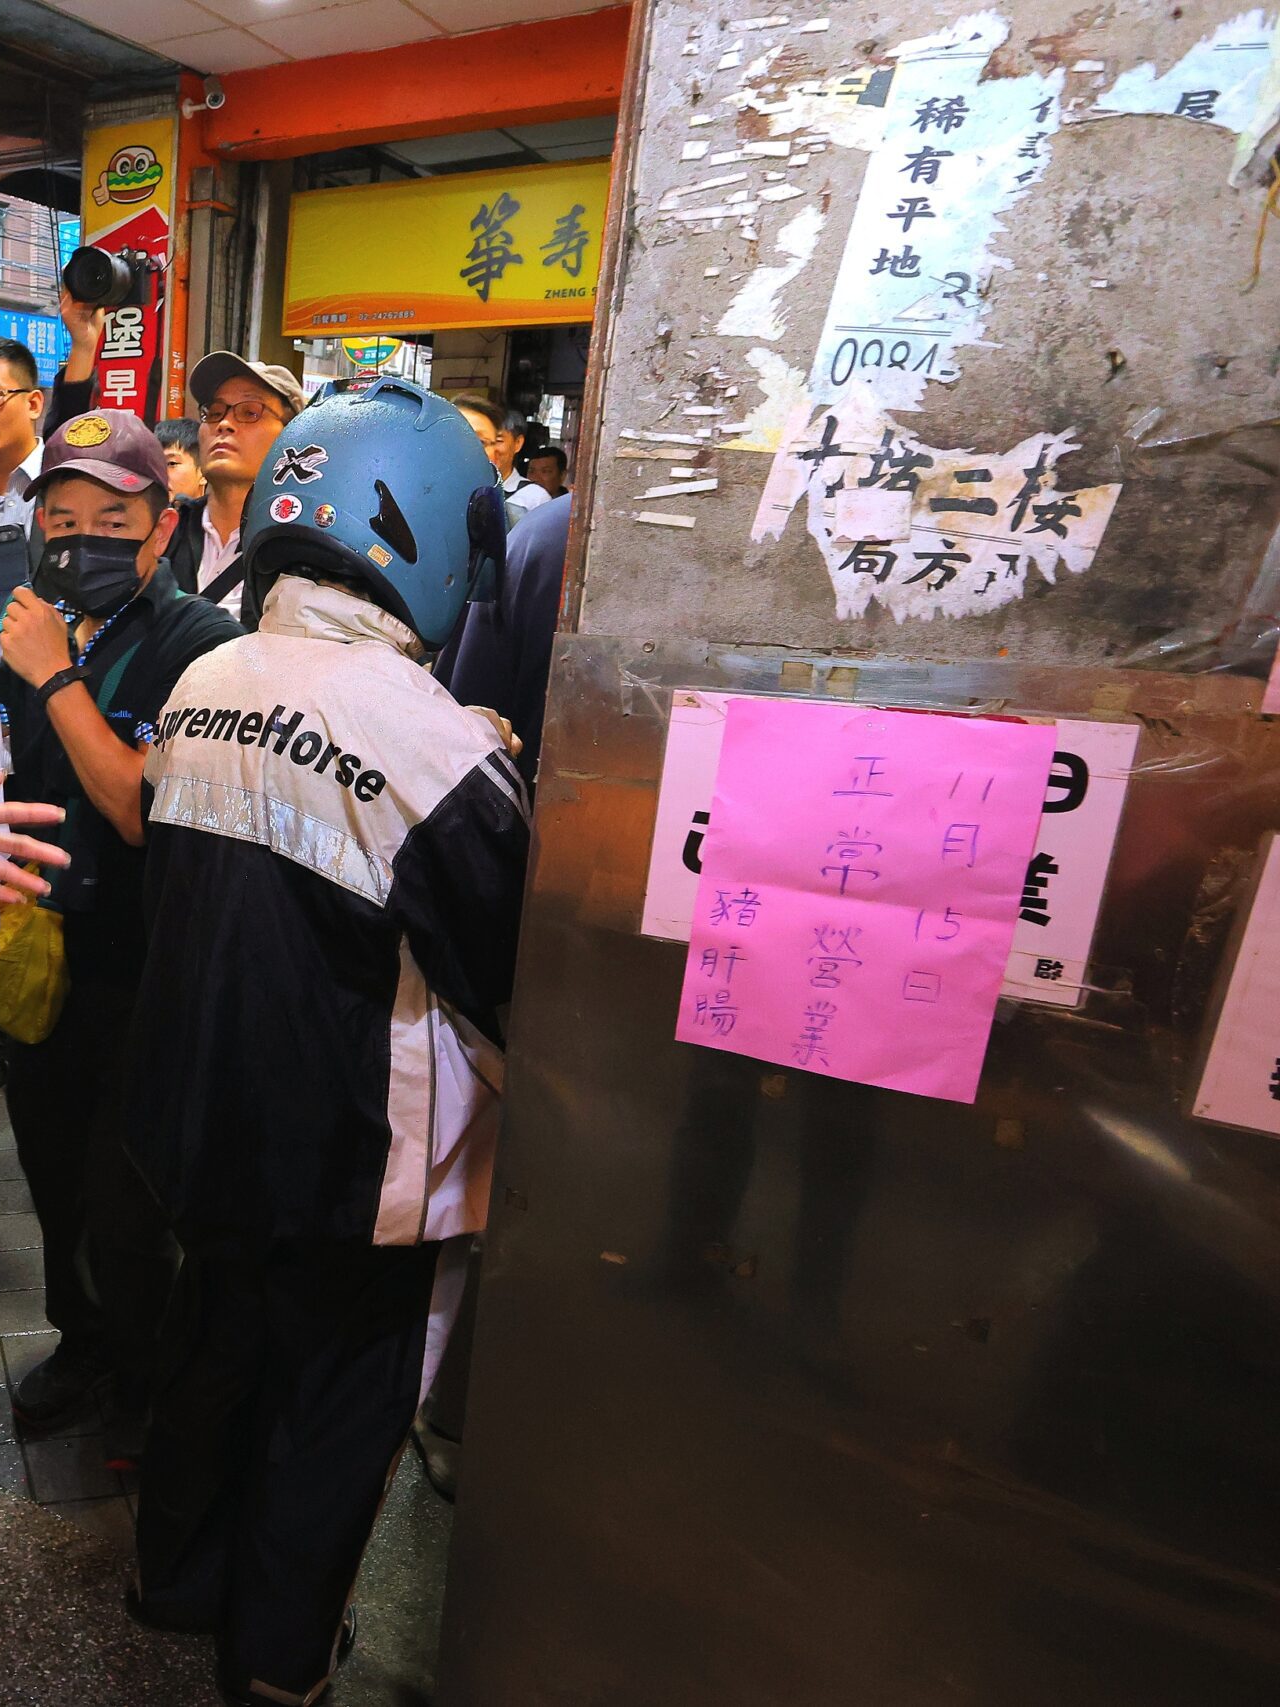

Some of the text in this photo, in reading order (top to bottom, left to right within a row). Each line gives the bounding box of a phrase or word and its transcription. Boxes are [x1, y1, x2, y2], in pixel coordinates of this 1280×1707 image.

[869, 95, 970, 278] 稀有平地
[544, 287, 586, 299] ZHENG
[692, 886, 763, 1037] 豬肝腸
